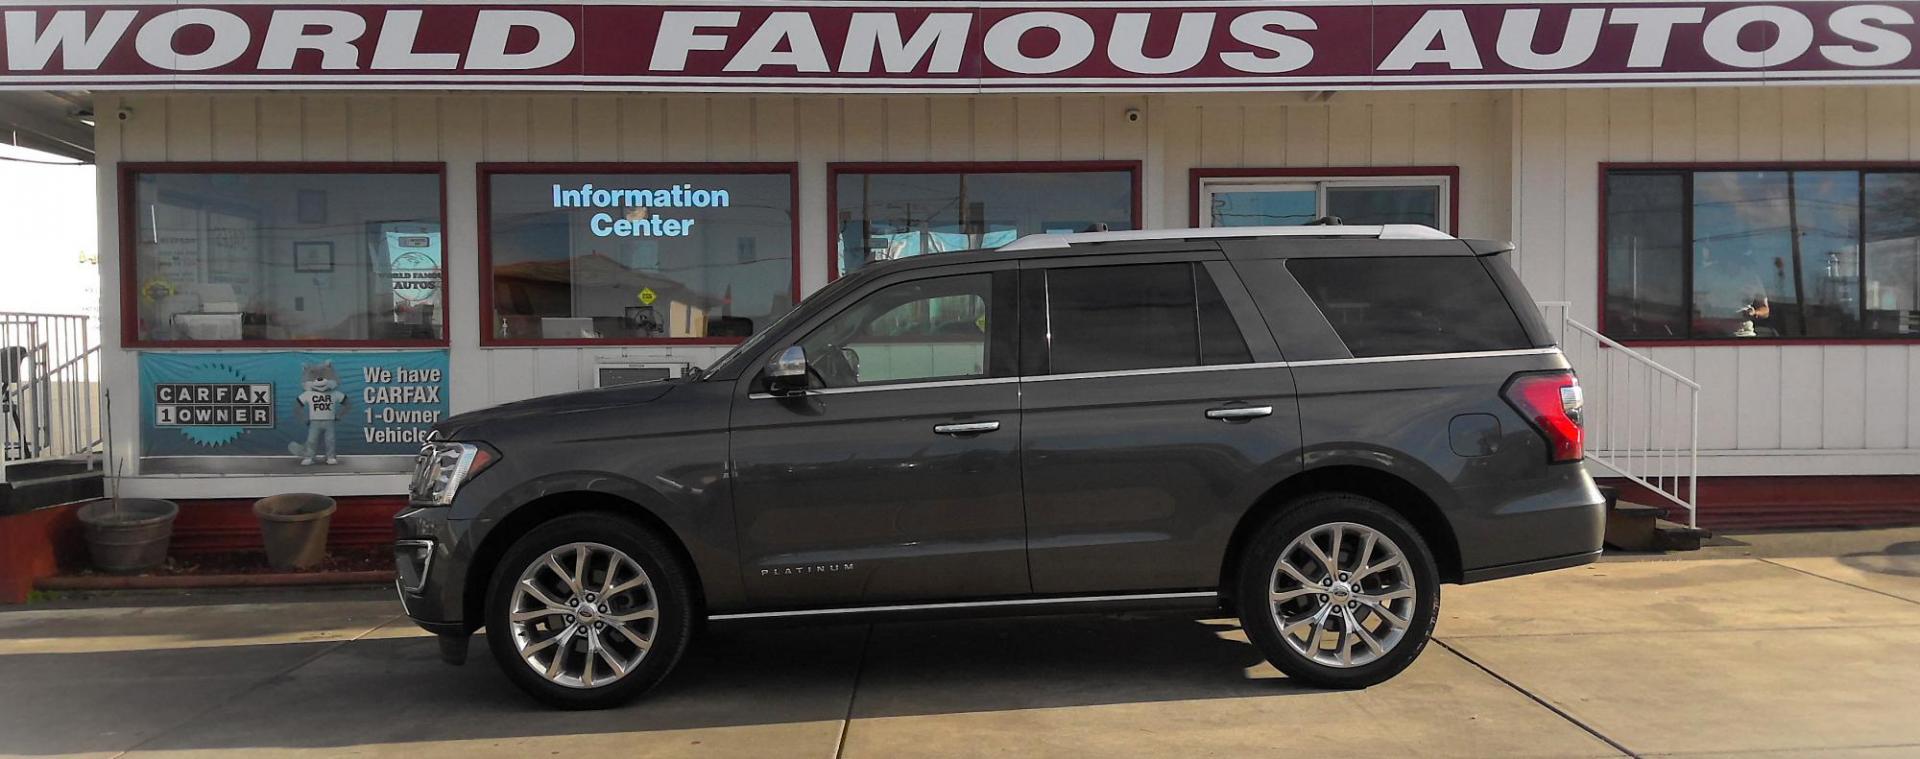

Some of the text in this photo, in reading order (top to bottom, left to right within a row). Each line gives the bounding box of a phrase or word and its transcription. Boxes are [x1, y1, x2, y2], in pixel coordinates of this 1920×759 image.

[4, 4, 1916, 74] WORLD FAMOUS AUTOS
[551, 183, 730, 208] Information
[589, 212, 695, 237] Center
[393, 281, 436, 290] AUTOS
[363, 367, 441, 383] We have
[159, 387, 269, 403] CARFAX
[312, 394, 332, 403] CAR
[363, 386, 439, 404] CARFAX
[313, 403, 332, 411] FOX
[364, 407, 441, 423] 1-Owner
[363, 427, 431, 443] Vehicle
[760, 563, 854, 576] PLATINUM
